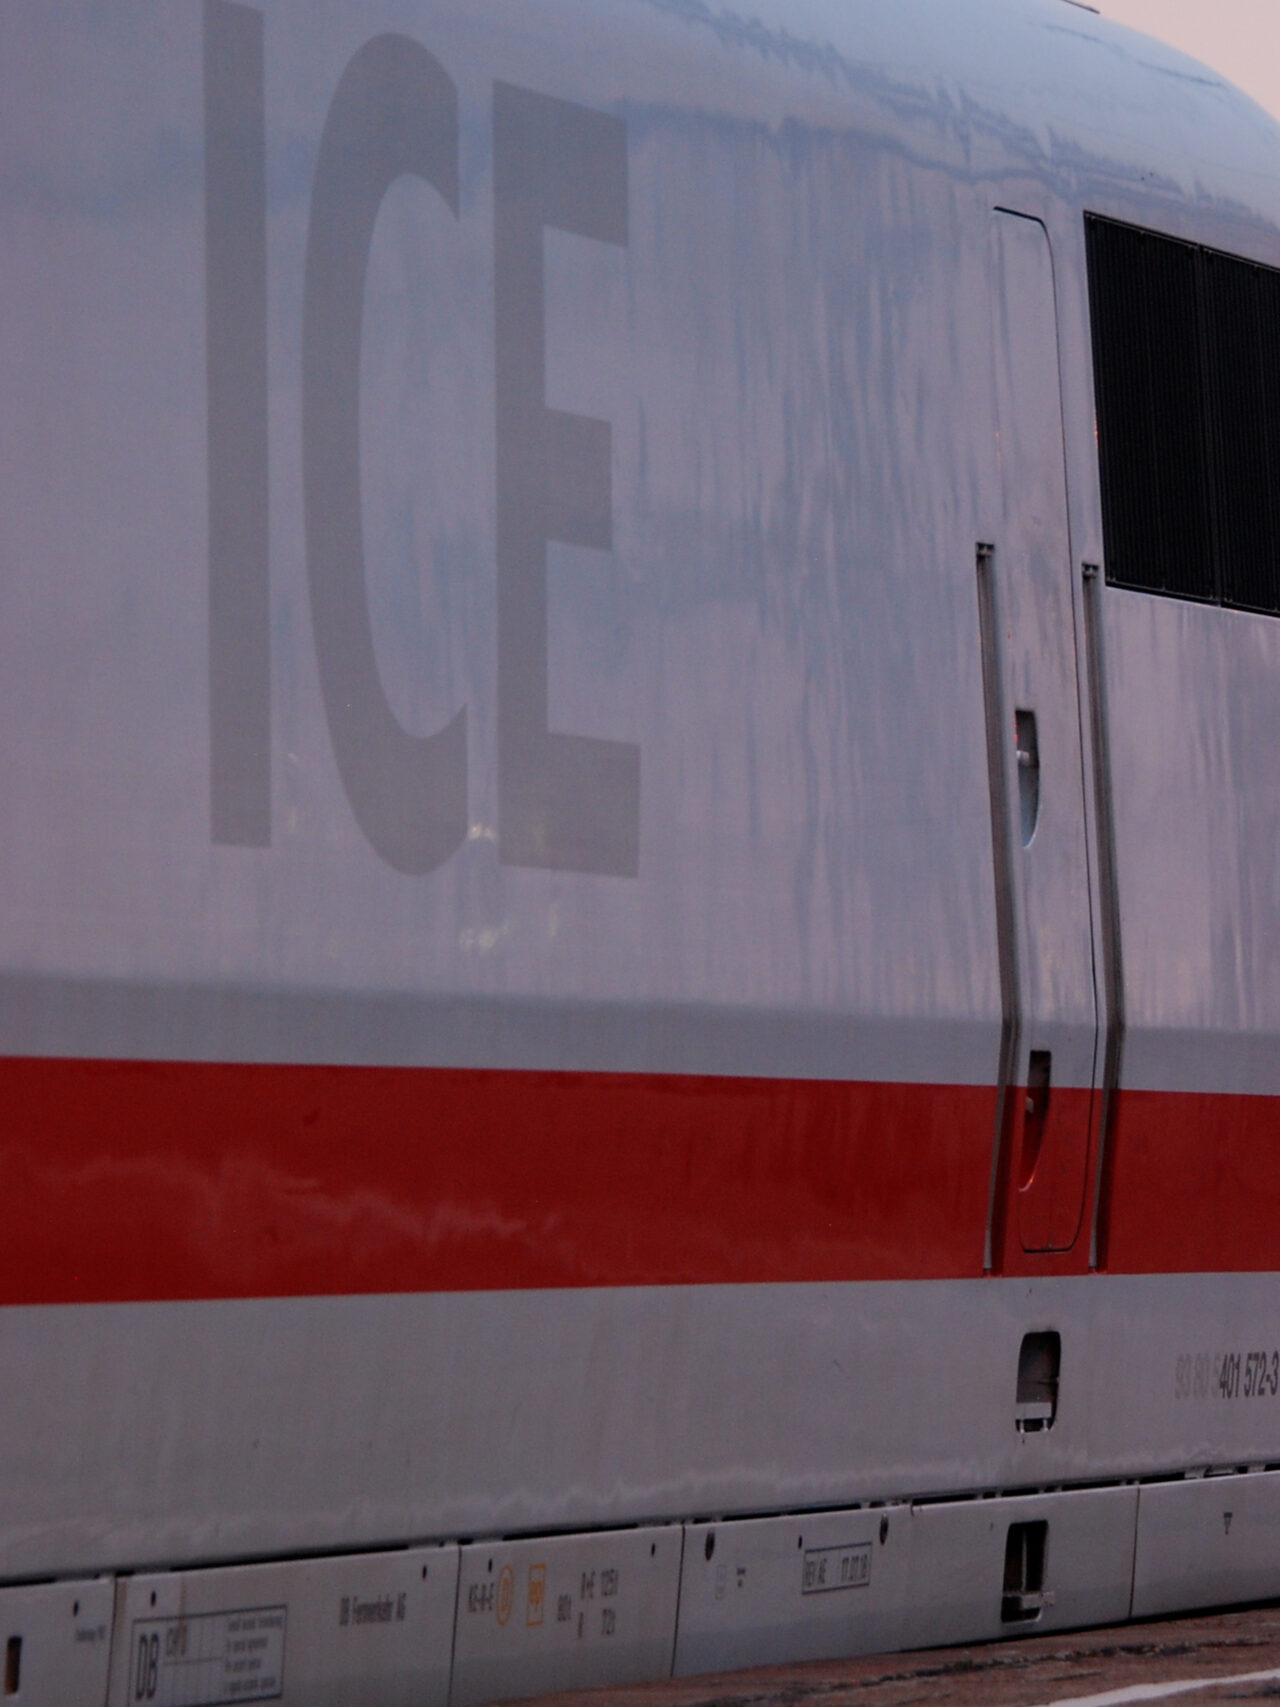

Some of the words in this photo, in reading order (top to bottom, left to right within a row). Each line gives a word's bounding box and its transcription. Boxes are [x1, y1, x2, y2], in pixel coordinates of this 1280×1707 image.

[204, 0, 641, 879] ICE
[1243, 1351, 1279, 1397] 572-3
[135, 1633, 160, 1700] DB
